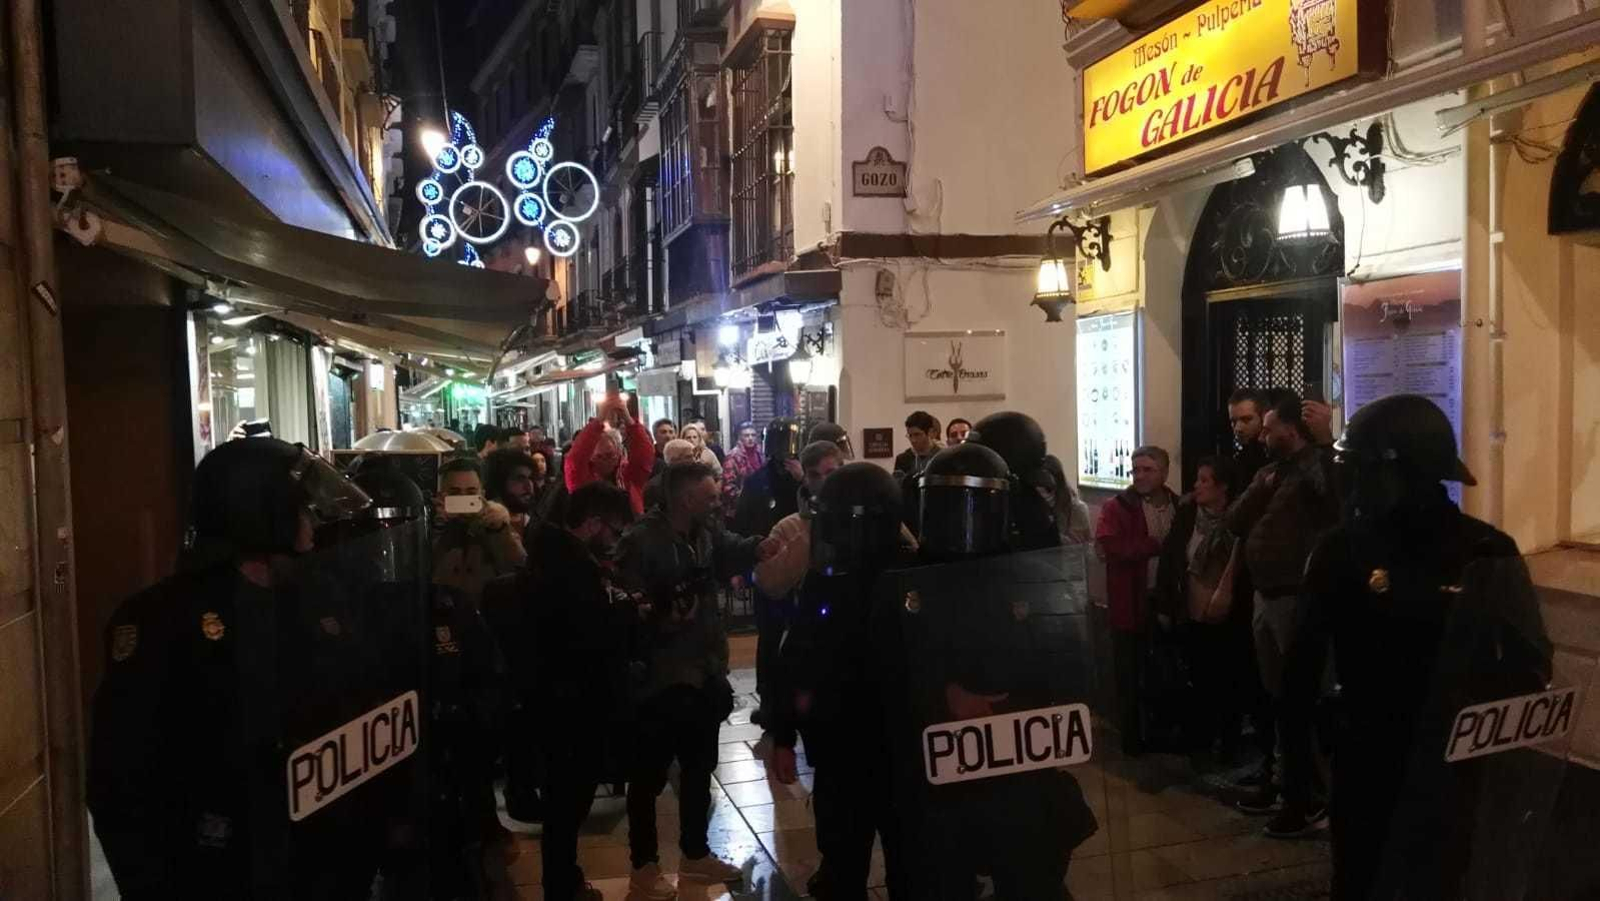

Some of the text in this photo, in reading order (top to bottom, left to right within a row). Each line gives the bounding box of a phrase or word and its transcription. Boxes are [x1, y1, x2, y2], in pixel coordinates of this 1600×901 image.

[1133, 31, 1178, 69] Mesón
[1089, 62, 1203, 130] FOGON de
[1140, 55, 1286, 148] GALICIA
[861, 173, 897, 186] GOZO
[291, 698, 417, 814] POLICIA
[926, 709, 1090, 778] POLICIA
[1449, 691, 1575, 755] POLICIA
